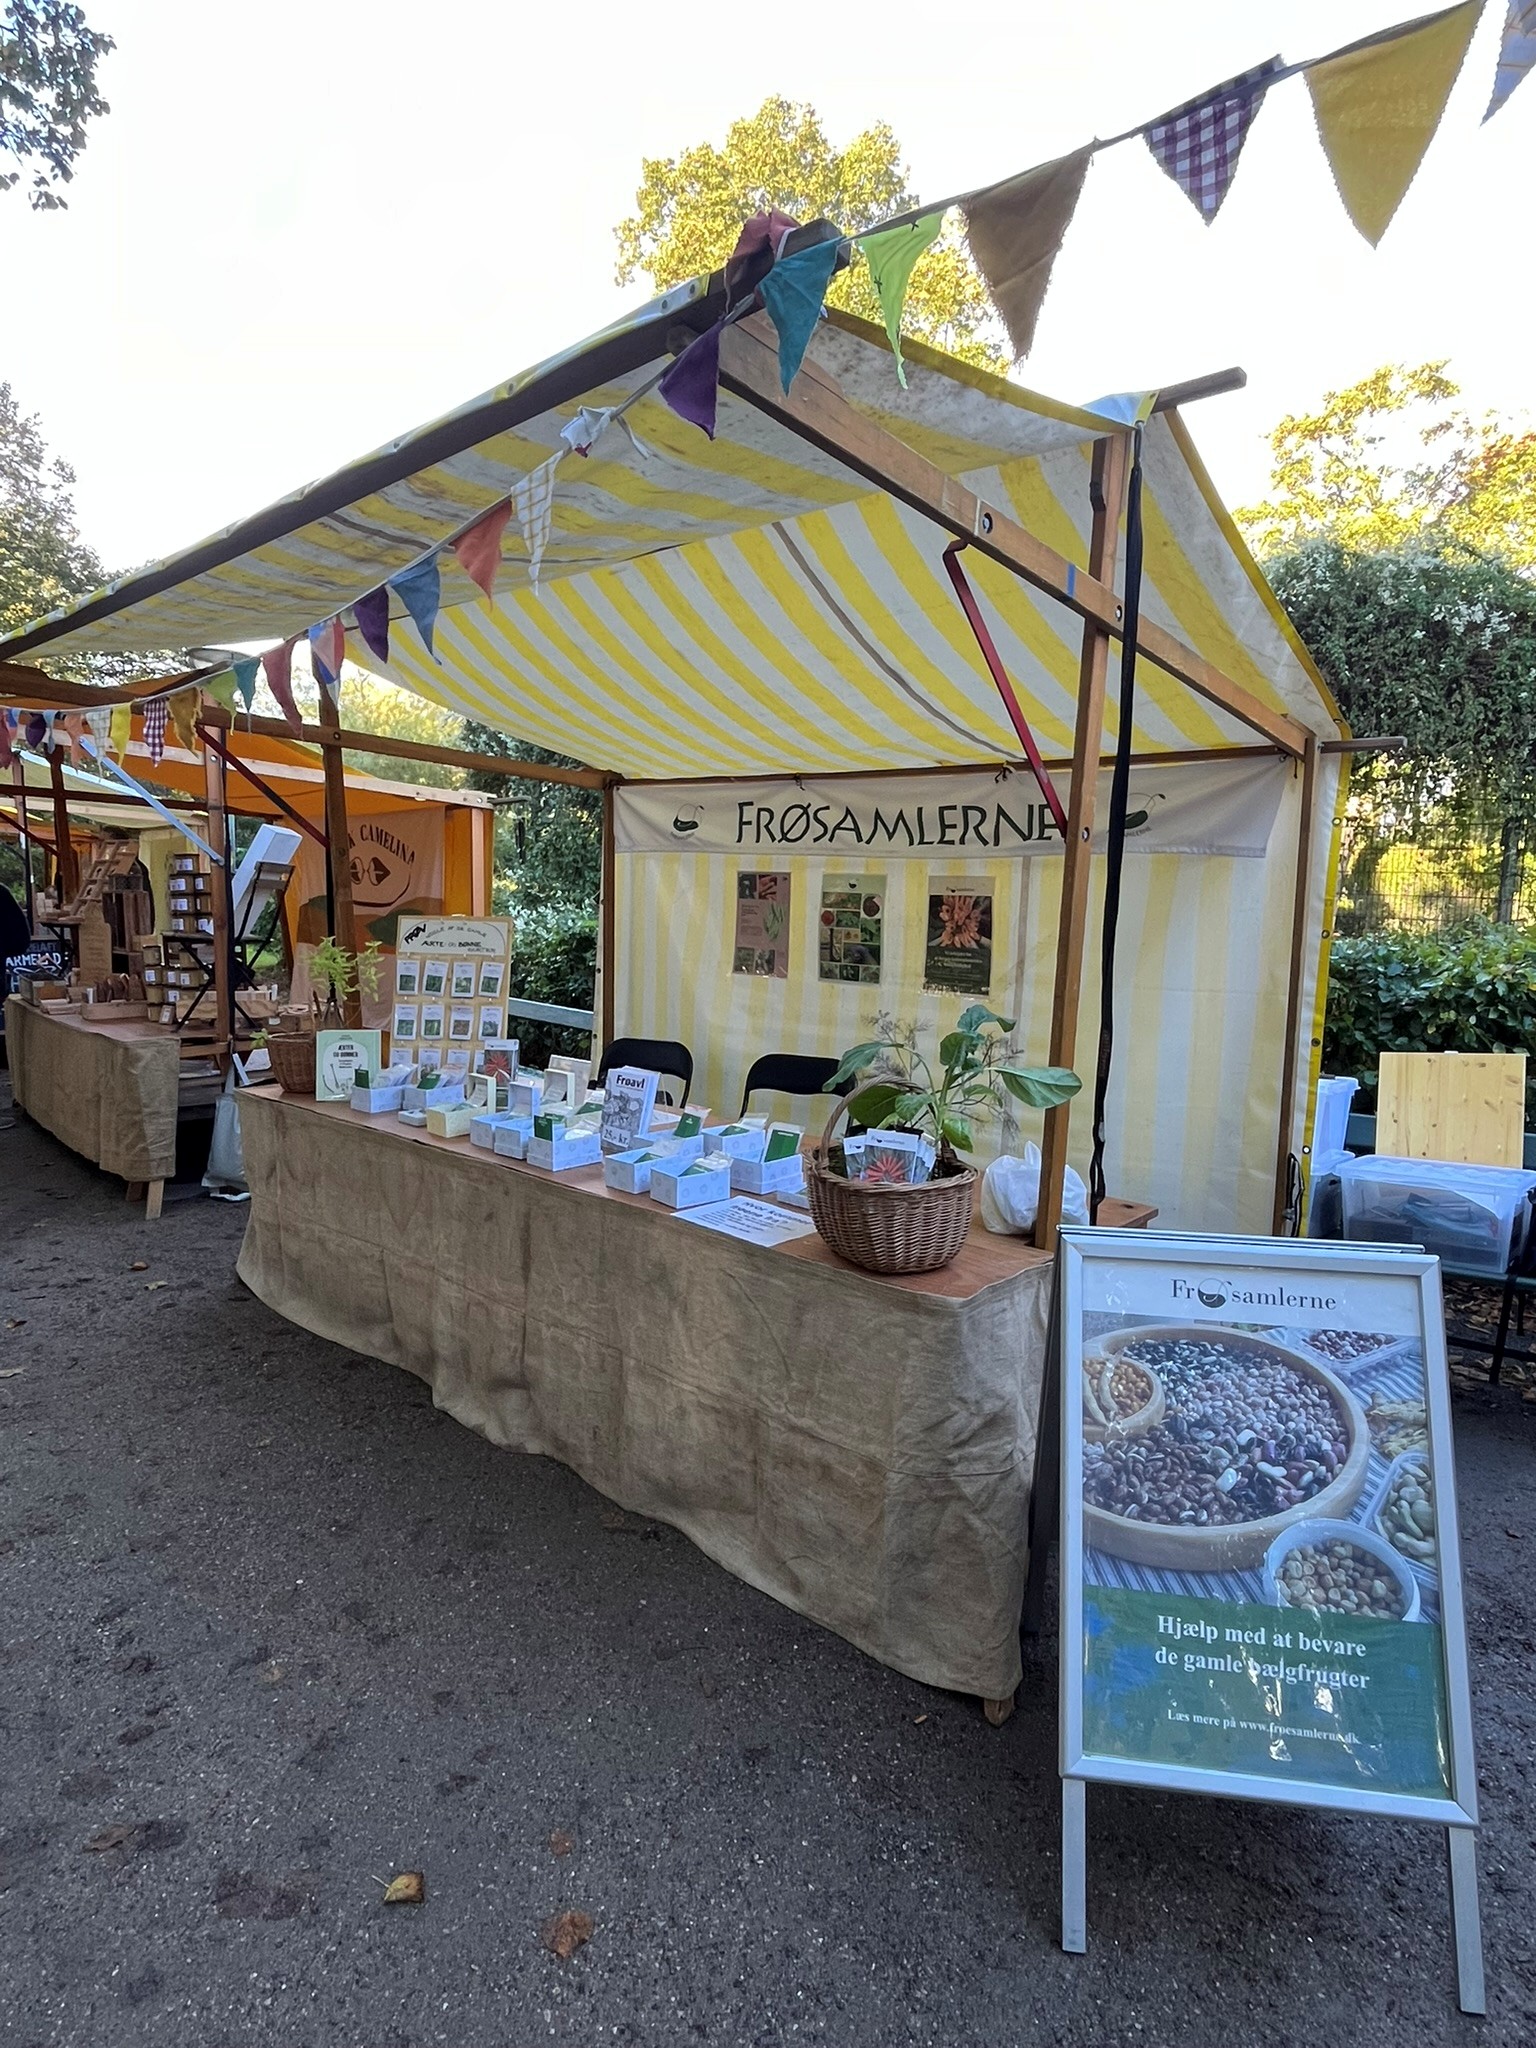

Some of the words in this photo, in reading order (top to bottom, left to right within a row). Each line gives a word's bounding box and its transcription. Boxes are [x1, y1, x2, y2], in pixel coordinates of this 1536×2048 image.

[360, 824, 415, 865] CAMELINA
[736, 801, 1060, 846] FRØSAMLERNE
[1157, 1615, 1218, 1643] Hjælp
[1225, 1627, 1266, 1645] med
[1273, 1631, 1293, 1648] at
[1299, 1632, 1367, 1657] bevare
[1155, 1647, 1178, 1665] de
[1184, 1654, 1243, 1673] gamle
[1249, 1657, 1370, 1689] bælgfrugter
[1168, 1709, 1190, 1723] Læs
[1193, 1715, 1220, 1726] mere
[1223, 1718, 1236, 1729] på
[1239, 1720, 1361, 1745] www.froesamlerndk
